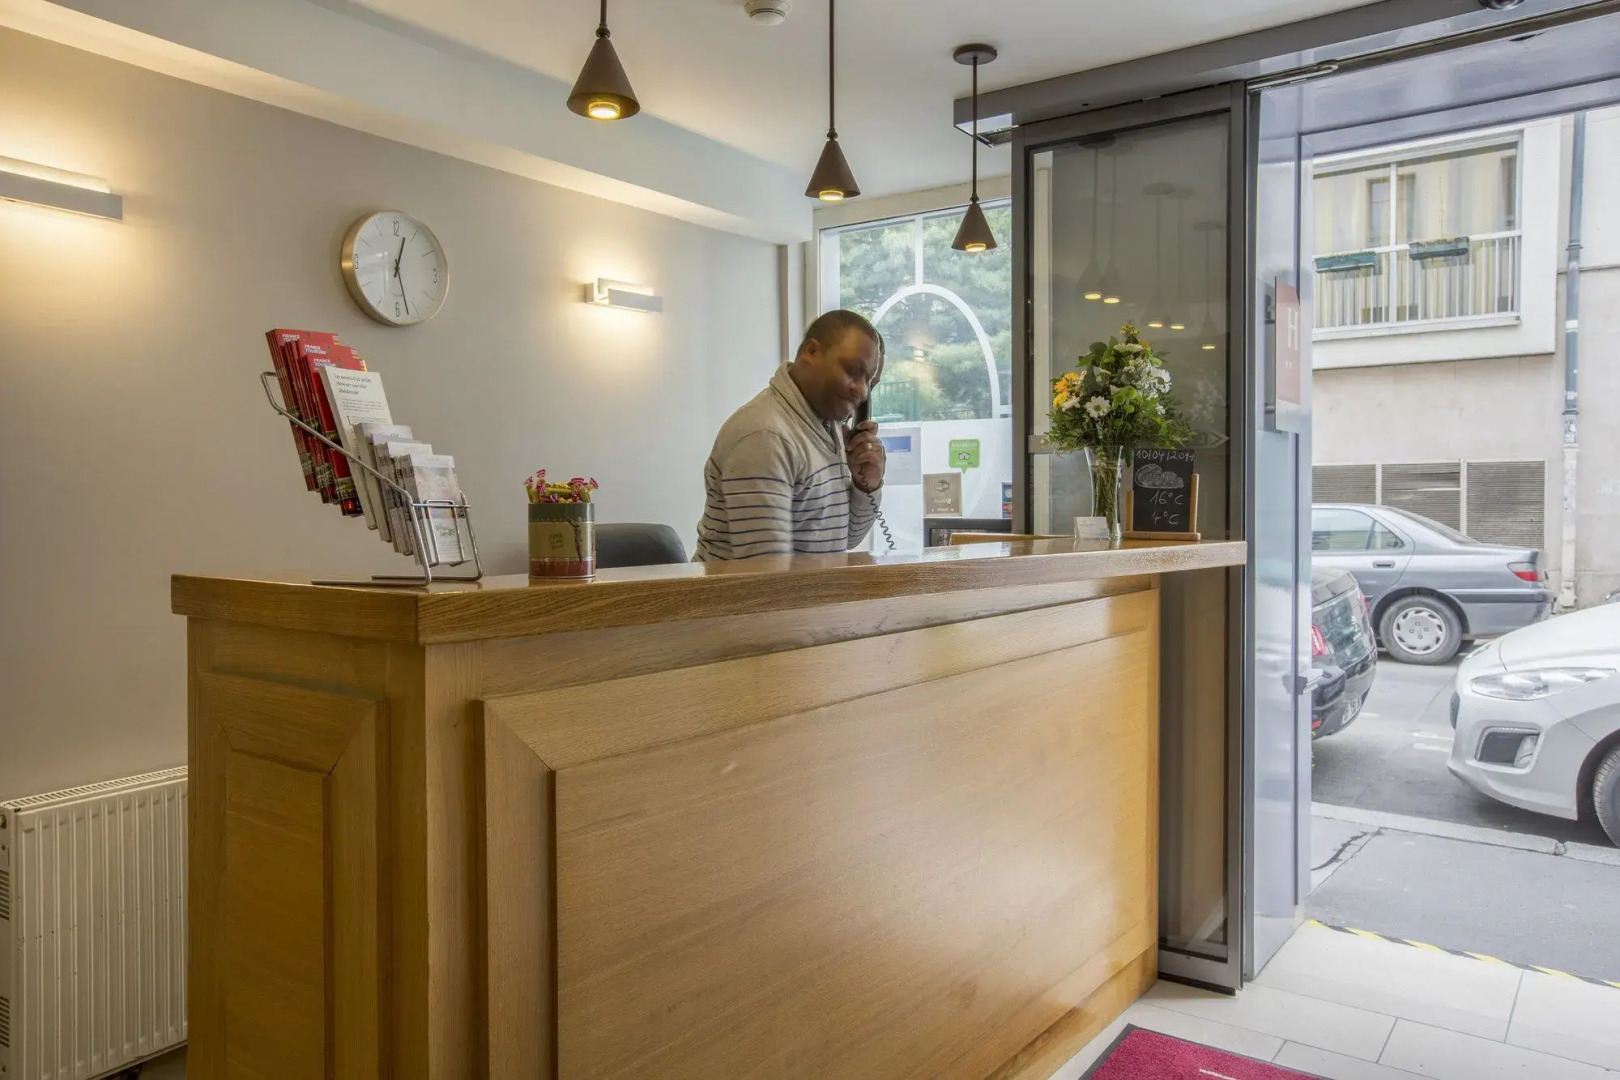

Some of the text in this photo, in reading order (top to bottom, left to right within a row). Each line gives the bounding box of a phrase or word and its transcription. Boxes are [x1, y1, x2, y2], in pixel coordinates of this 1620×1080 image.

[393, 220, 400, 237] 12
[432, 268, 438, 283] 3
[395, 302, 400, 317] 6
[1286, 308, 1299, 351] H
